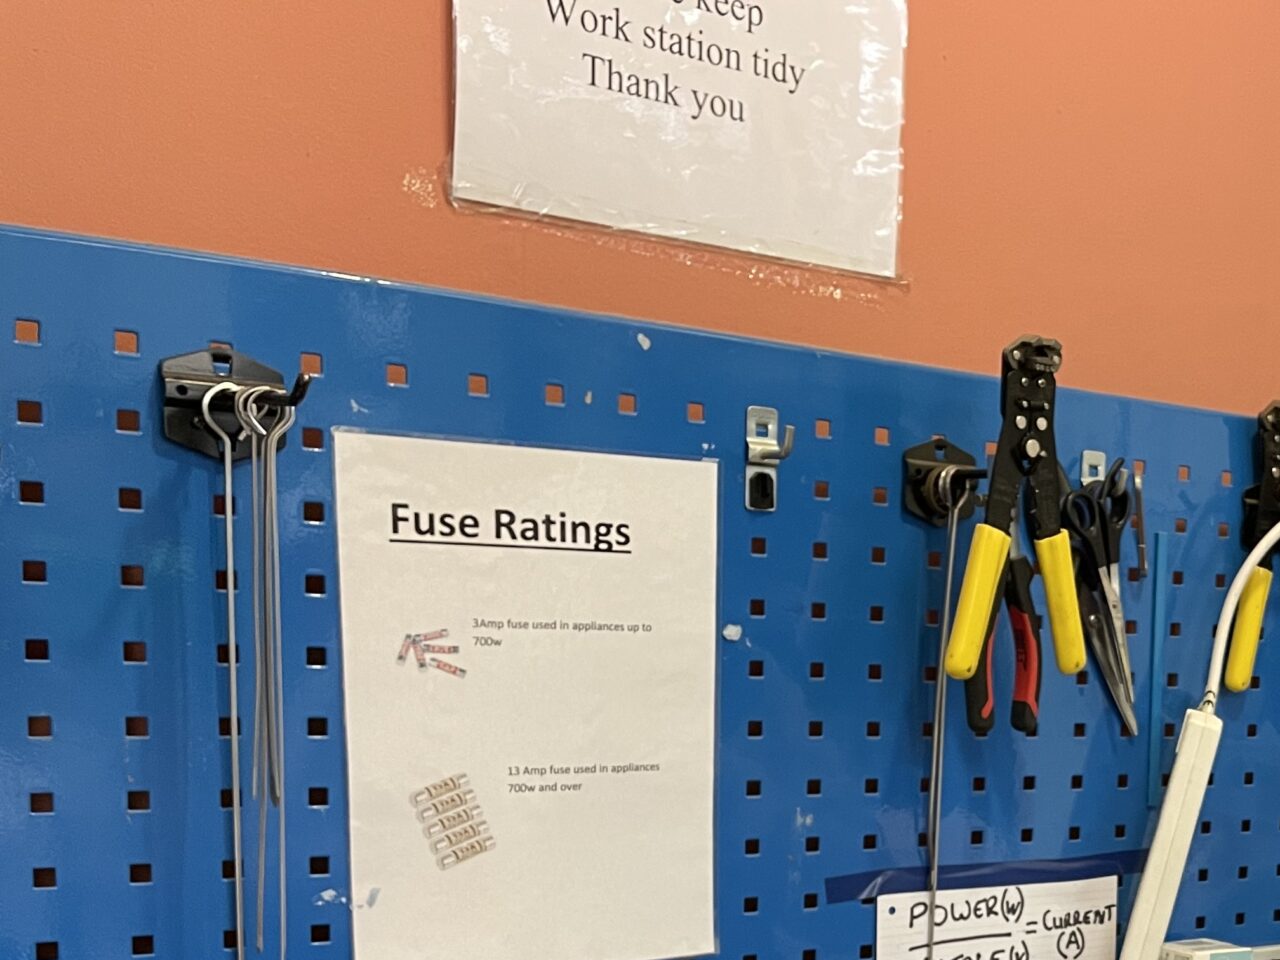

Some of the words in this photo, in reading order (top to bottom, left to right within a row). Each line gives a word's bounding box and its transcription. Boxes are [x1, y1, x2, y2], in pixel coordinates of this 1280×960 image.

[546, 0, 632, 43] Work
[643, 24, 742, 71] station
[752, 48, 806, 94] tidy
[582, 53, 681, 107] Thank
[691, 88, 745, 122] you
[391, 503, 480, 537] Fuse
[494, 508, 631, 552] Ratings
[472, 618, 505, 630] 3Amp
[507, 619, 530, 629] fuse
[532, 620, 557, 630] used
[559, 620, 569, 630] in
[572, 620, 625, 632] appliances
[627, 623, 640, 633] up
[641, 623, 652, 632] to
[472, 636, 502, 647] 700w
[507, 766, 521, 776] 13
[523, 766, 547, 776] Amp
[549, 764, 571, 775] fuse
[573, 763, 597, 773] used
[599, 763, 609, 772] in
[610, 762, 660, 773] appliances
[507, 783, 536, 793] 700w
[538, 782, 558, 792] and
[560, 783, 582, 791] over
